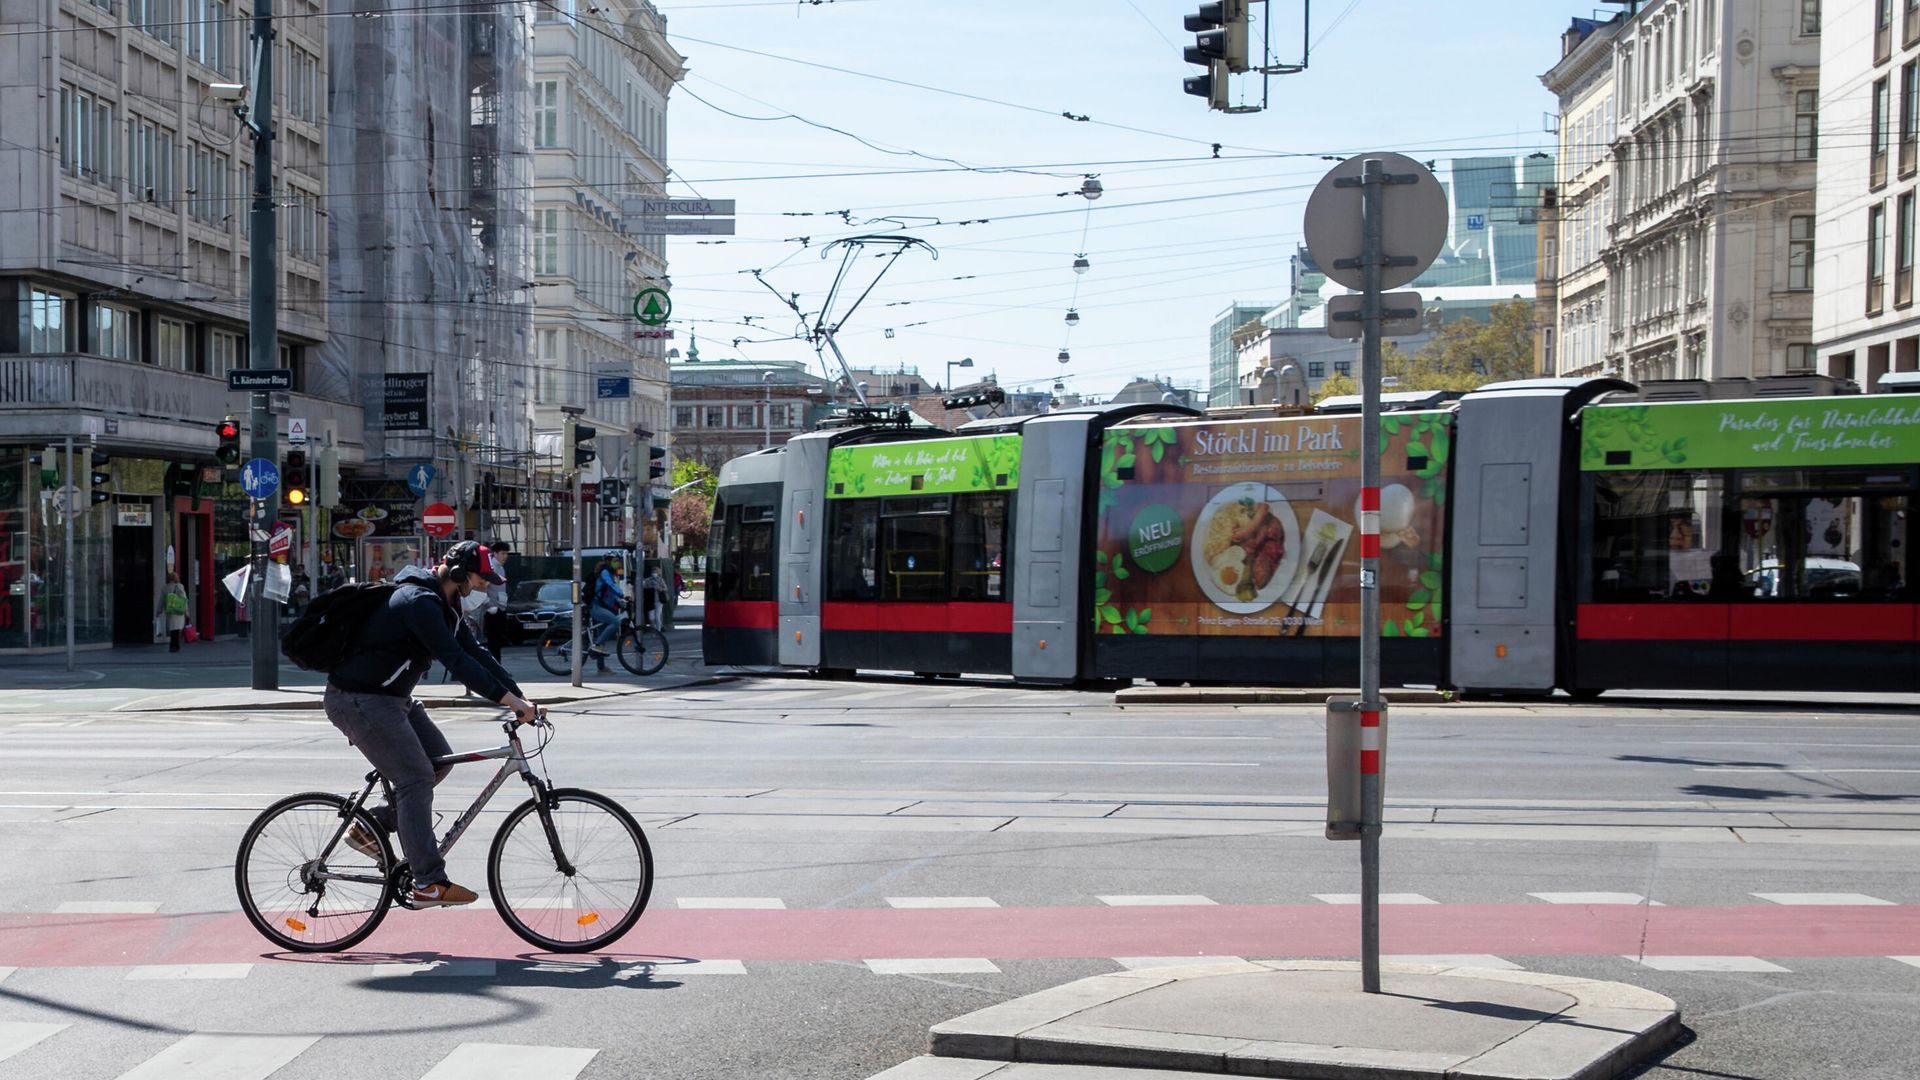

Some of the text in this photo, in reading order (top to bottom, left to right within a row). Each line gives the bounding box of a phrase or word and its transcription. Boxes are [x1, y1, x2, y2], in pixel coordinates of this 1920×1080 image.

[1469, 216, 1483, 224] TU
[240, 375, 271, 385] Kärntner
[271, 375, 288, 386] Ring
[81, 378, 191, 416] MEINL BANK
[600, 389, 613, 398] JP
[1194, 424, 1344, 456] Stöckl im Park
[1139, 520, 1172, 543] NEU
